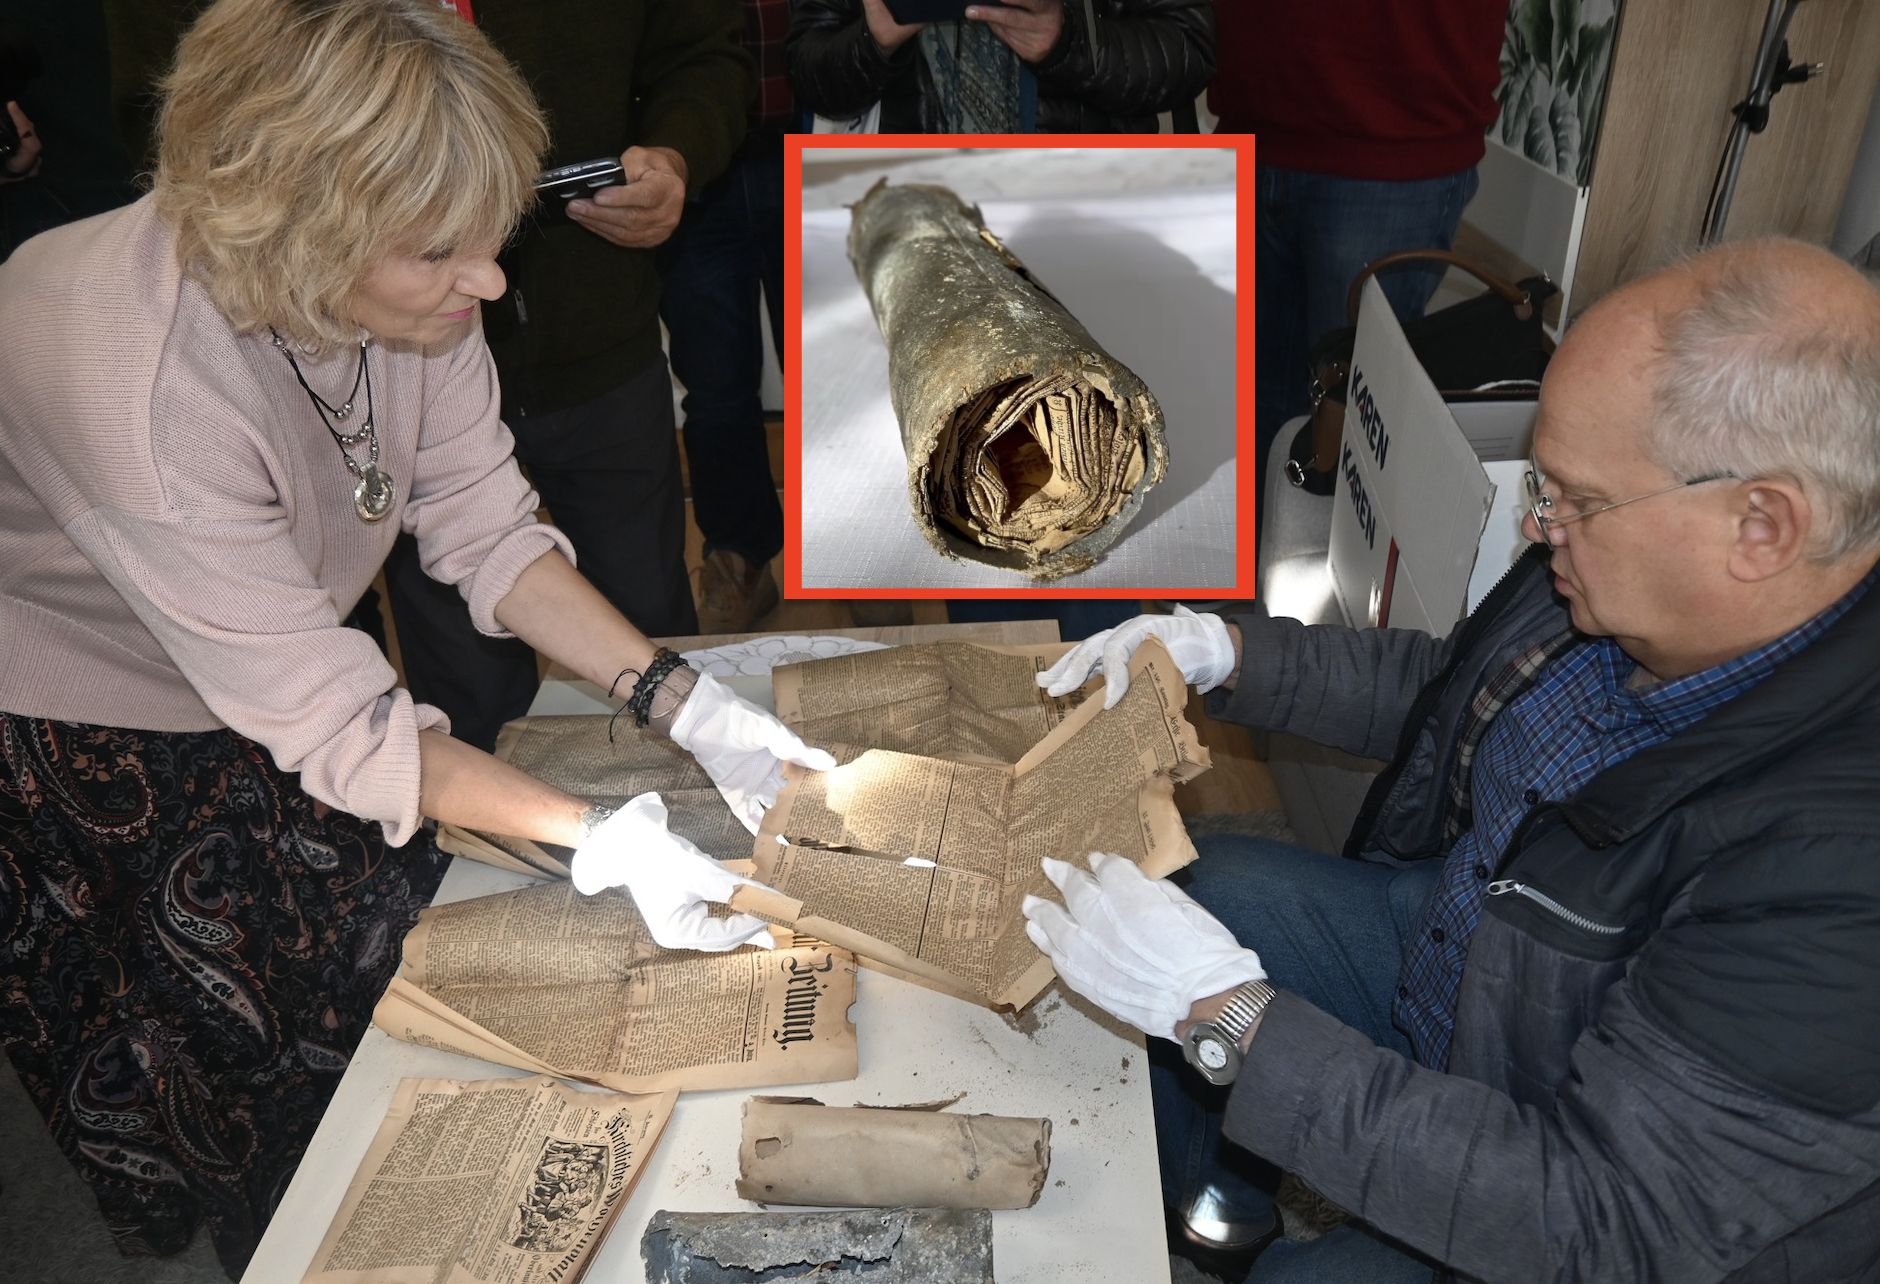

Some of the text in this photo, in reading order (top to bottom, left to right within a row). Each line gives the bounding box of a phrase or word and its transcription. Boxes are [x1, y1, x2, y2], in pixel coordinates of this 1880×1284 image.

[1351, 365, 1389, 471] KAREN
[1341, 440, 1376, 550] KAREN
[773, 953, 833, 1051] Zeitung.
[600, 1107, 634, 1189] Kirchliches
